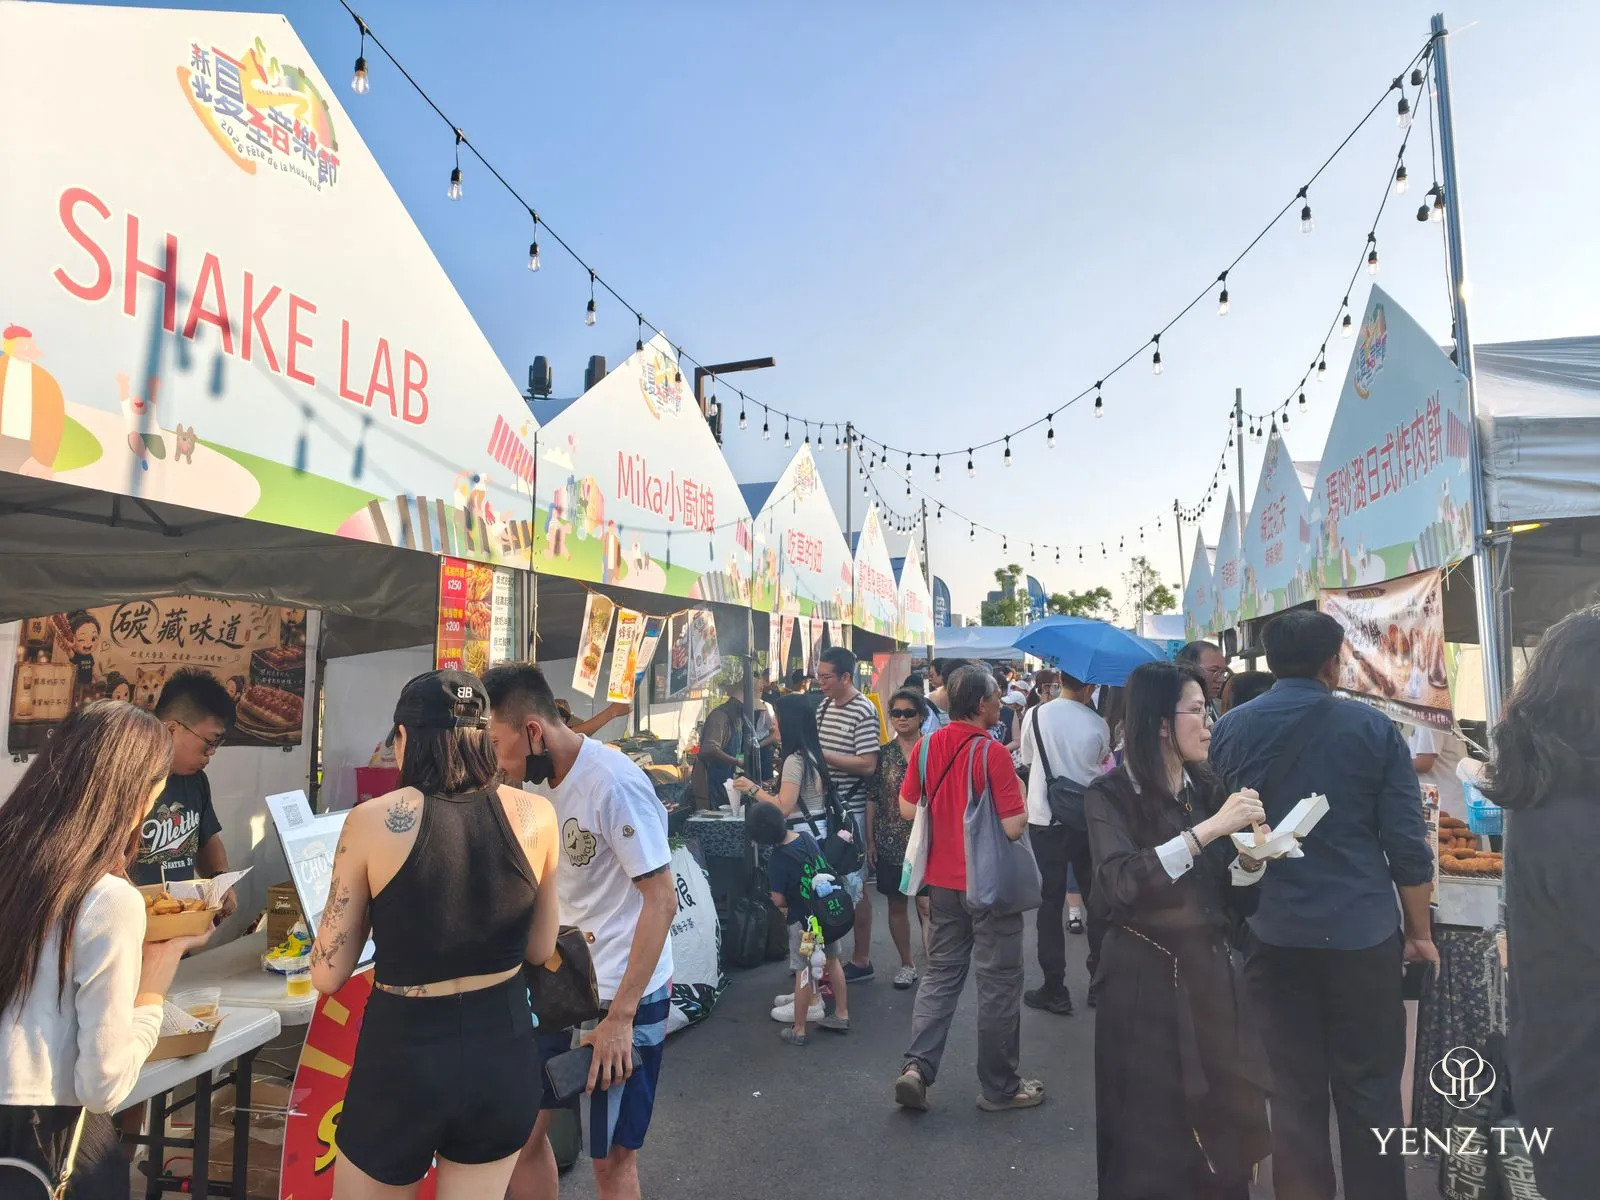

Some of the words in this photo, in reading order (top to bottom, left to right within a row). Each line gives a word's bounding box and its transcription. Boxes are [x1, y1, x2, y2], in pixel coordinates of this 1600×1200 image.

[289, 163, 322, 192] Musique
[53, 187, 317, 387] SHAKE
[338, 319, 430, 426] LAB
[617, 450, 716, 535] Mika小廚娘
[447, 579, 462, 591] $250
[114, 602, 246, 649] 碳藏味道
[570, 834, 592, 863] MONCLER
[827, 898, 842, 911] 21
